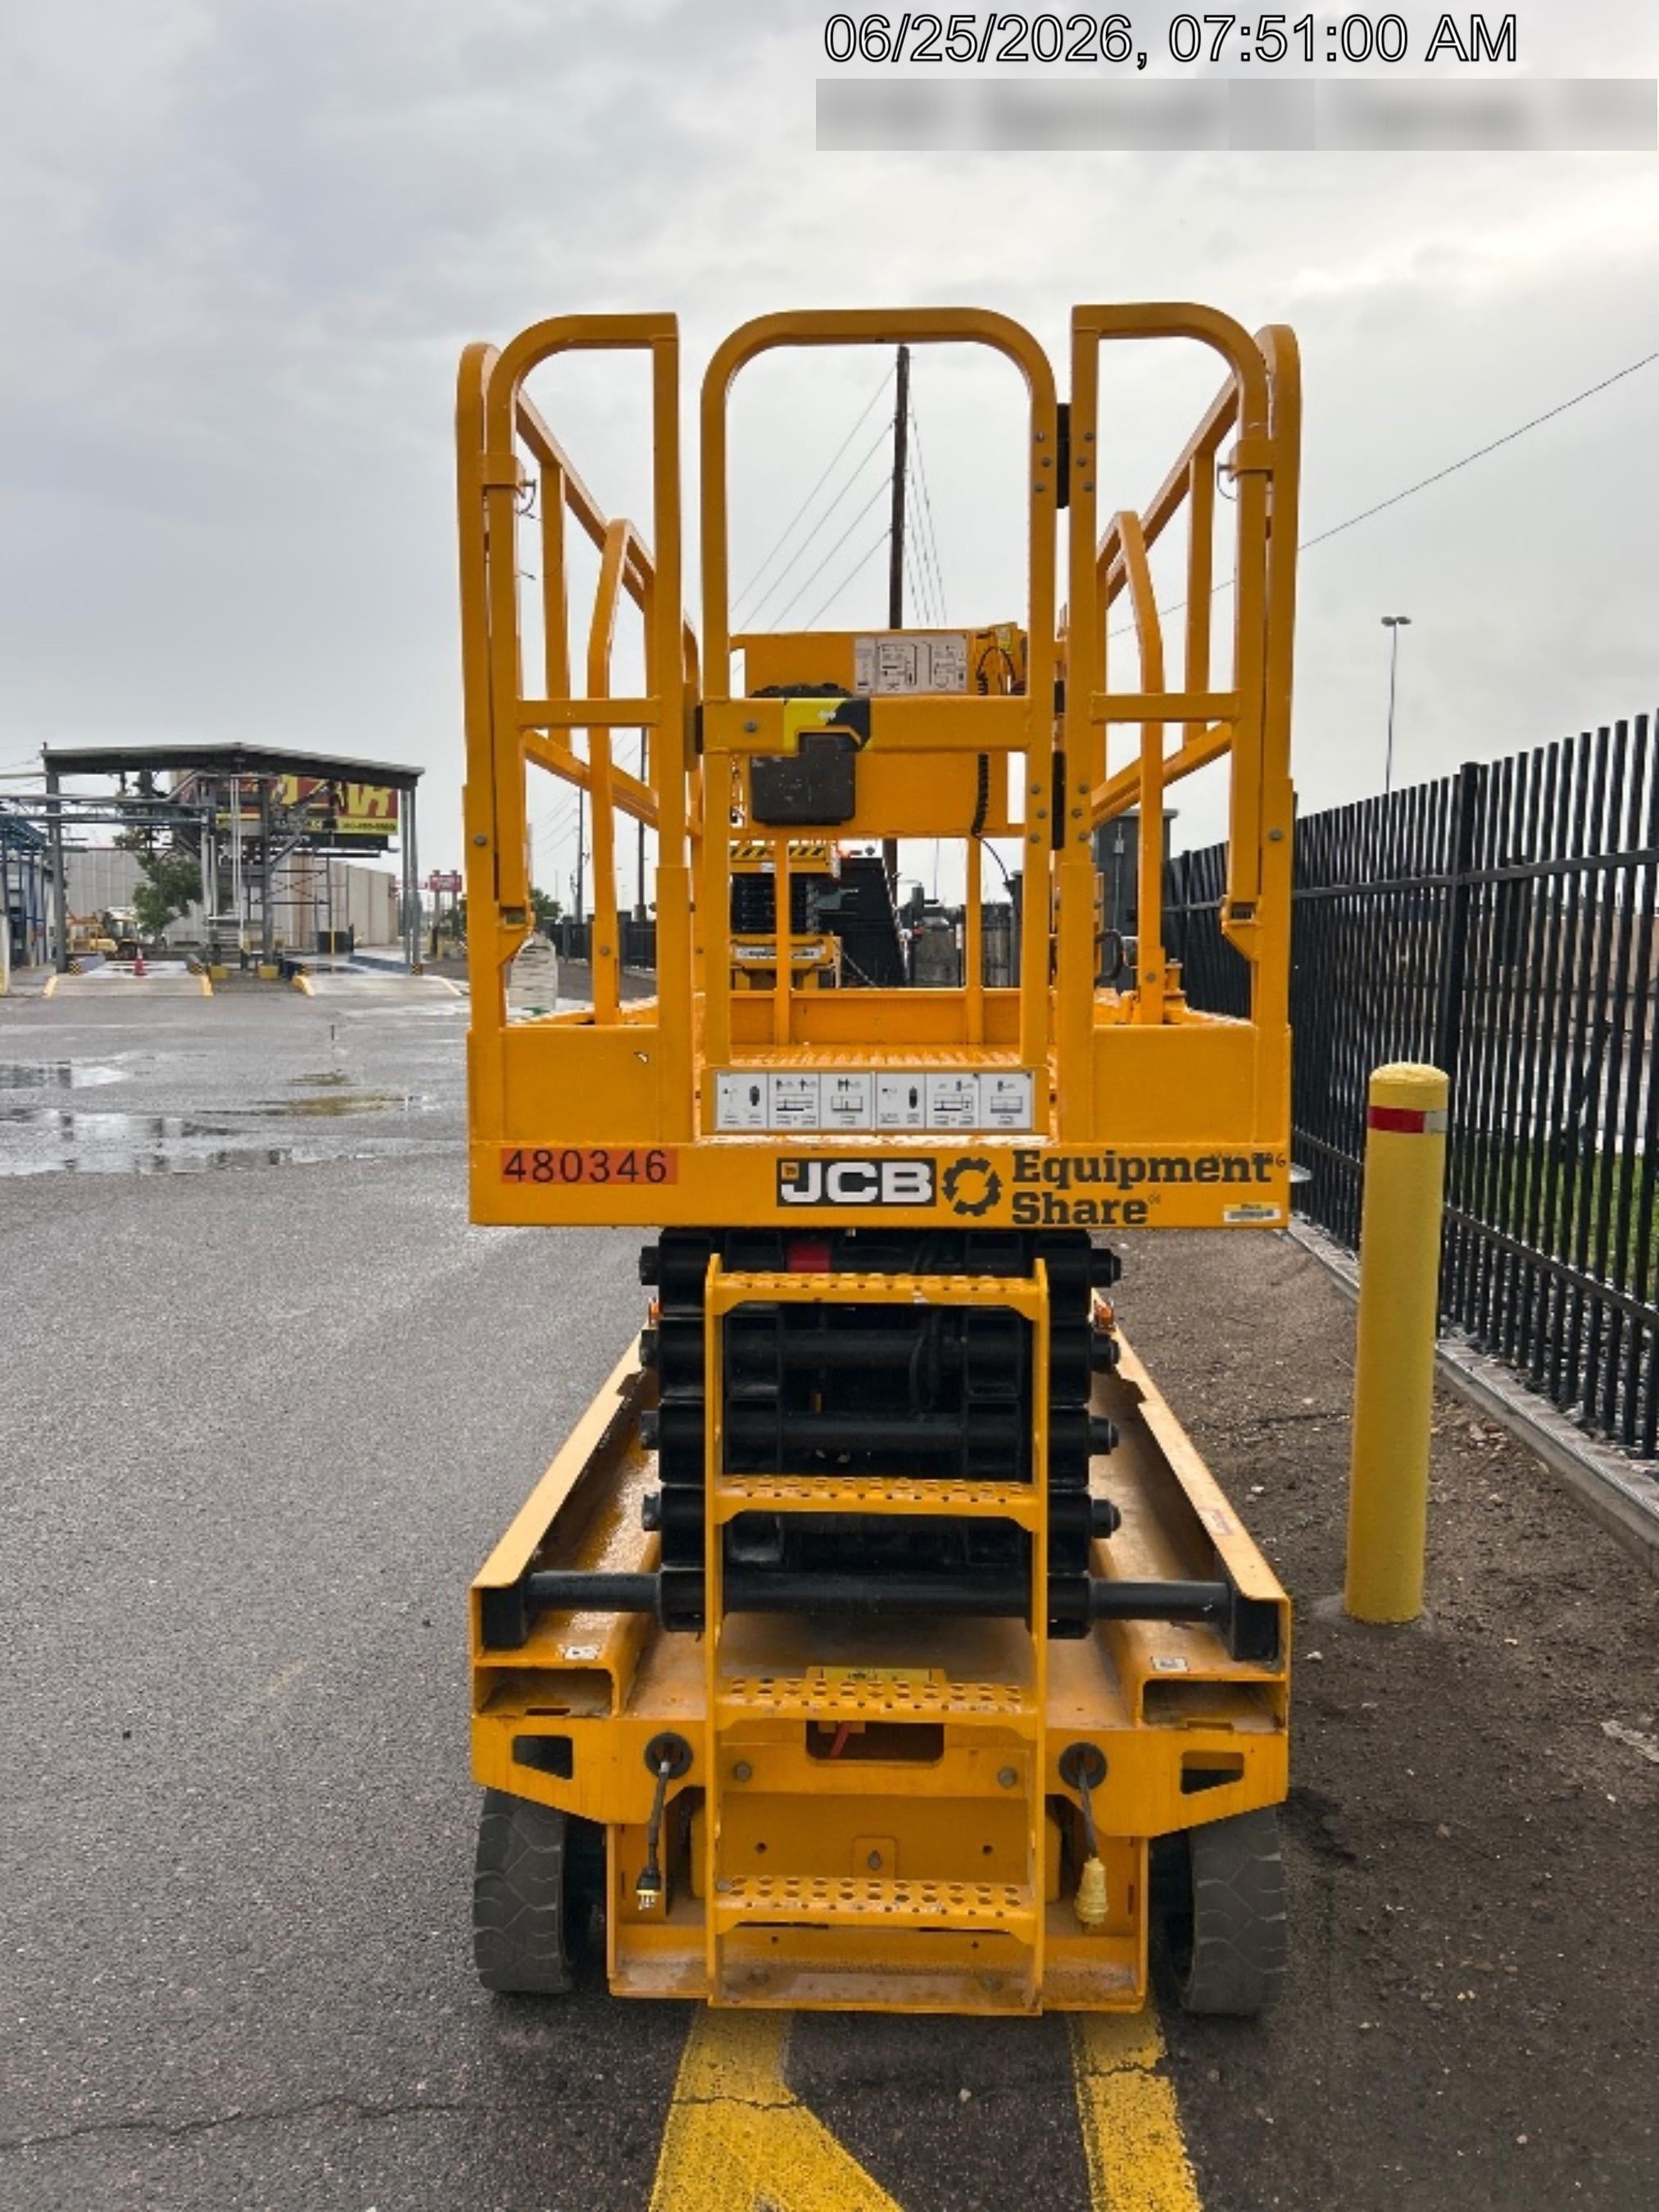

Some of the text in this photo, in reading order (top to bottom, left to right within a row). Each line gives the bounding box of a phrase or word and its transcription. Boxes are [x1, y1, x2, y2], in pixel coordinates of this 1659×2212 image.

[504, 1149, 667, 1183] 480346
[780, 1161, 932, 1203] JCB
[1013, 1149, 1272, 1190] Equipment
[1013, 1192, 1148, 1225] Share
